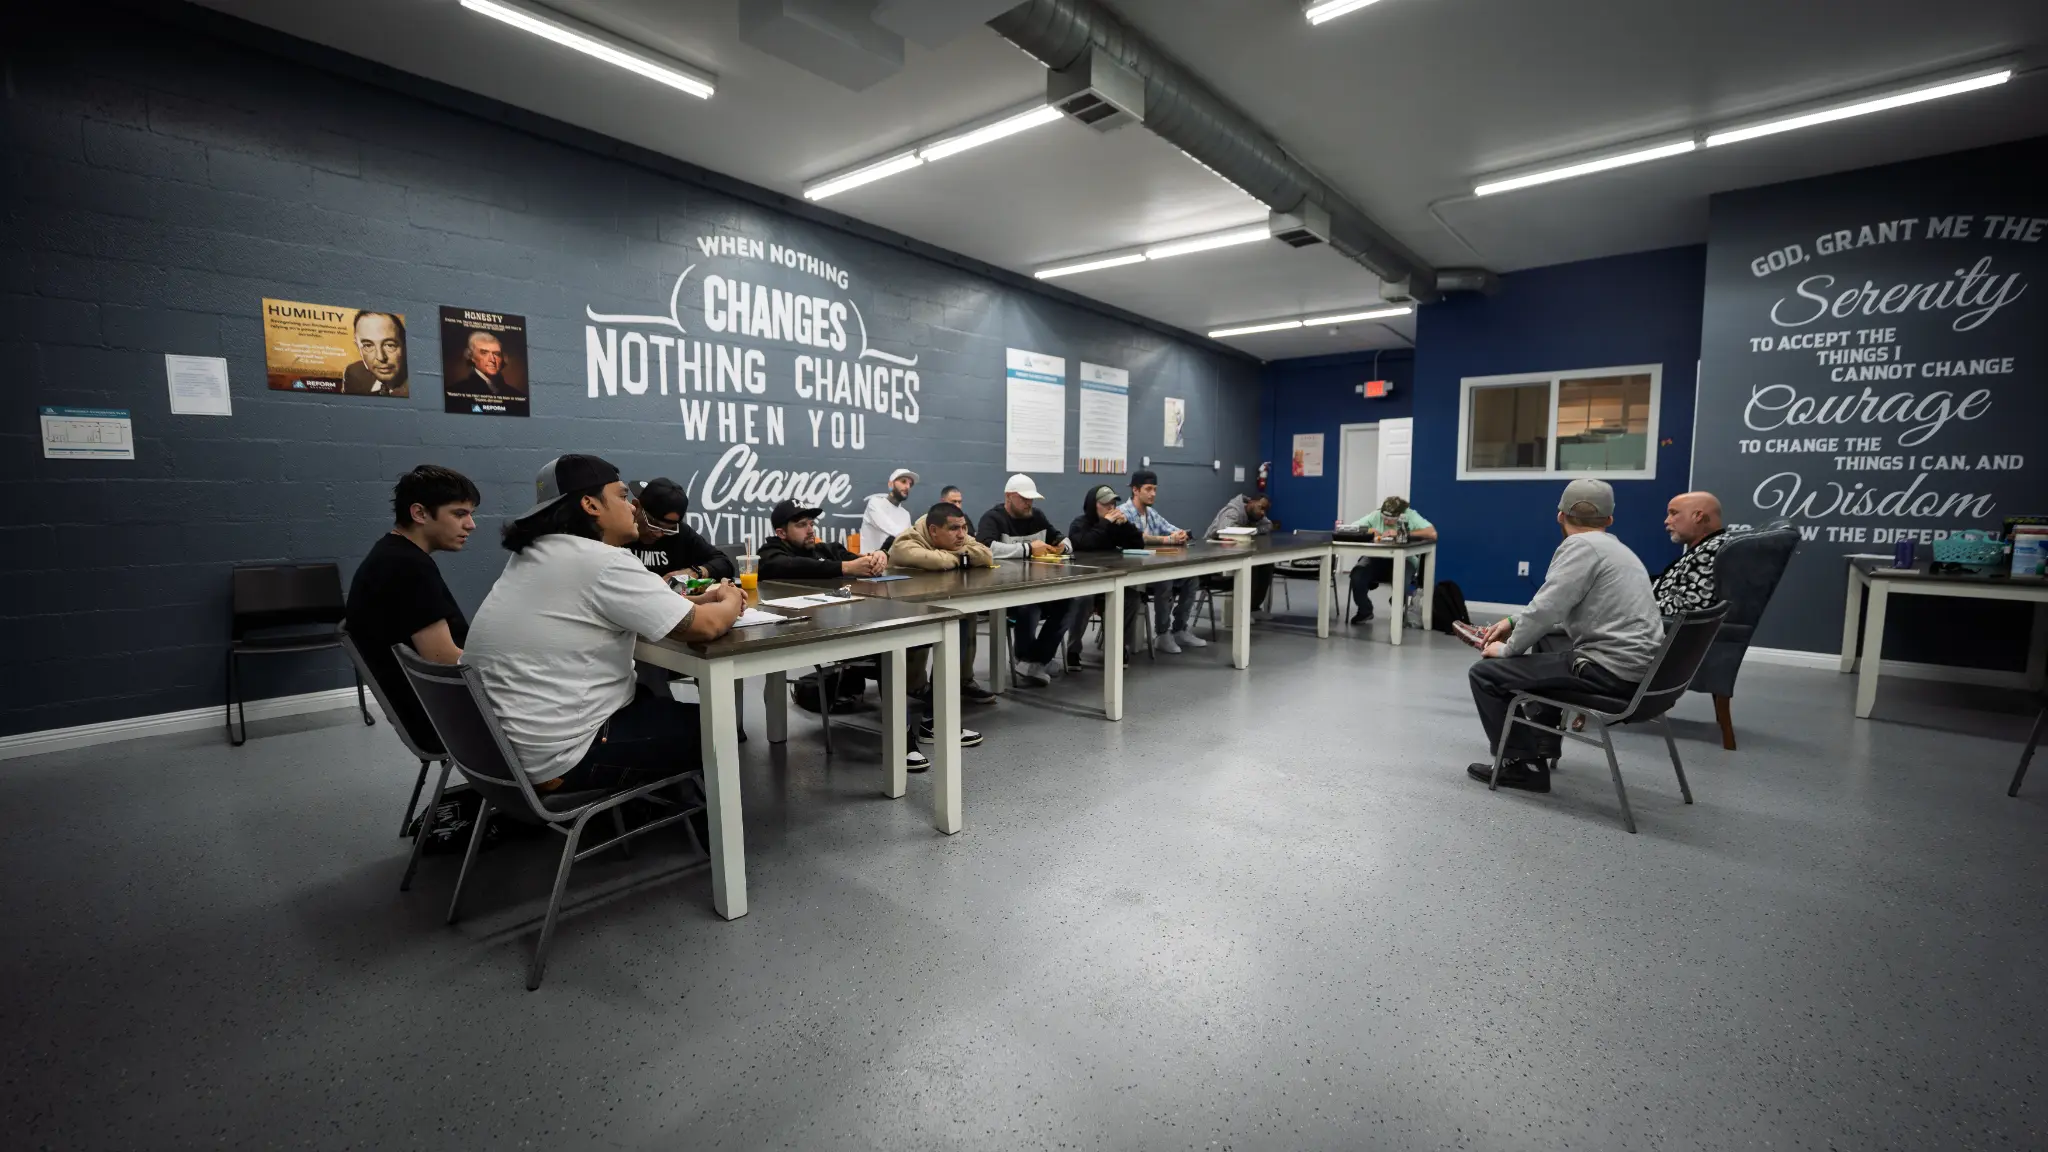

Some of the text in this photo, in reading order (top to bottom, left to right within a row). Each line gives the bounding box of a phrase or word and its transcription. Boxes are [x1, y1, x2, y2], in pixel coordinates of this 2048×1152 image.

[697, 236, 849, 290] WHEN NOTHING
[1751, 215, 2048, 278] GOD, GRANT ME THE
[1770, 256, 2027, 331] Serenity
[268, 304, 344, 323] HUMILITY
[464, 310, 503, 324] HONESTY
[703, 274, 847, 351] CHANGES
[1750, 328, 1897, 353] TO ACCEPT THE
[1817, 345, 1901, 366] THINGS I
[306, 379, 337, 388] REFORM
[586, 325, 920, 424] NOTHING CHANGES
[1831, 358, 2014, 382] CANNOT CHANGE
[680, 399, 865, 450] WHEN YOU
[1743, 383, 1992, 448] Courage
[1739, 437, 1882, 454] TO CHANGE THE
[701, 443, 852, 511] Change
[1834, 455, 2024, 473] THINGS I CAN, AND
[1752, 471, 1996, 519] Wisdom
[1826, 527, 1867, 542] THE
